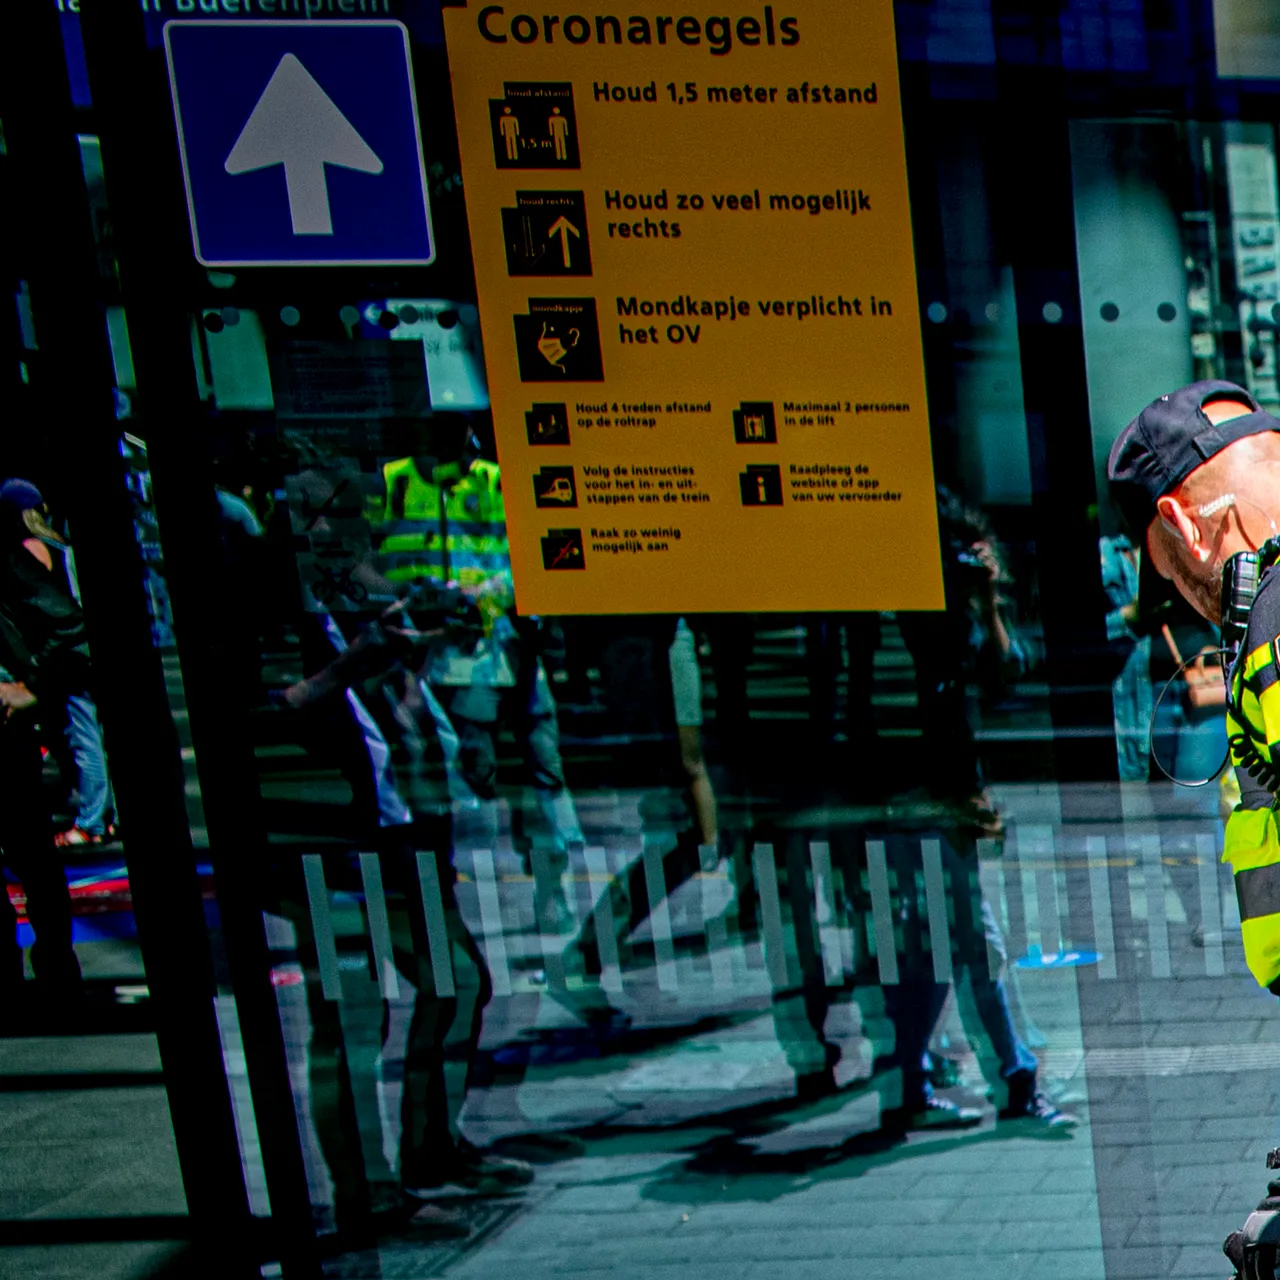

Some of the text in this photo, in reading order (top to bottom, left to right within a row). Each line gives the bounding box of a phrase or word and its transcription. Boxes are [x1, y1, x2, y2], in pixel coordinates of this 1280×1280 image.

[477, 5, 799, 55] Coronaregels
[593, 81, 877, 104] Houd 1,5 meter afstand
[605, 189, 871, 214] Houd zo veel mogelijk
[608, 217, 681, 237] rechts
[616, 295, 891, 320] Mondkapje verplicht in
[619, 323, 700, 343] het OV
[576, 401, 712, 413] Houd 4 treden afstand
[783, 401, 910, 414] Maximaal 2 personen
[577, 415, 657, 429] op de roltrap
[785, 415, 835, 426] in de lift
[583, 465, 694, 478] Volg de instructies
[790, 463, 869, 477] Raadpleeg de
[585, 479, 697, 490] voor het in- en uit-
[791, 477, 880, 489] website of app
[587, 491, 710, 505] stappen van de trein
[792, 490, 902, 502] van uw vervoerder
[590, 527, 681, 540] Raak zo weinig
[592, 540, 669, 554] mogelijk aan
